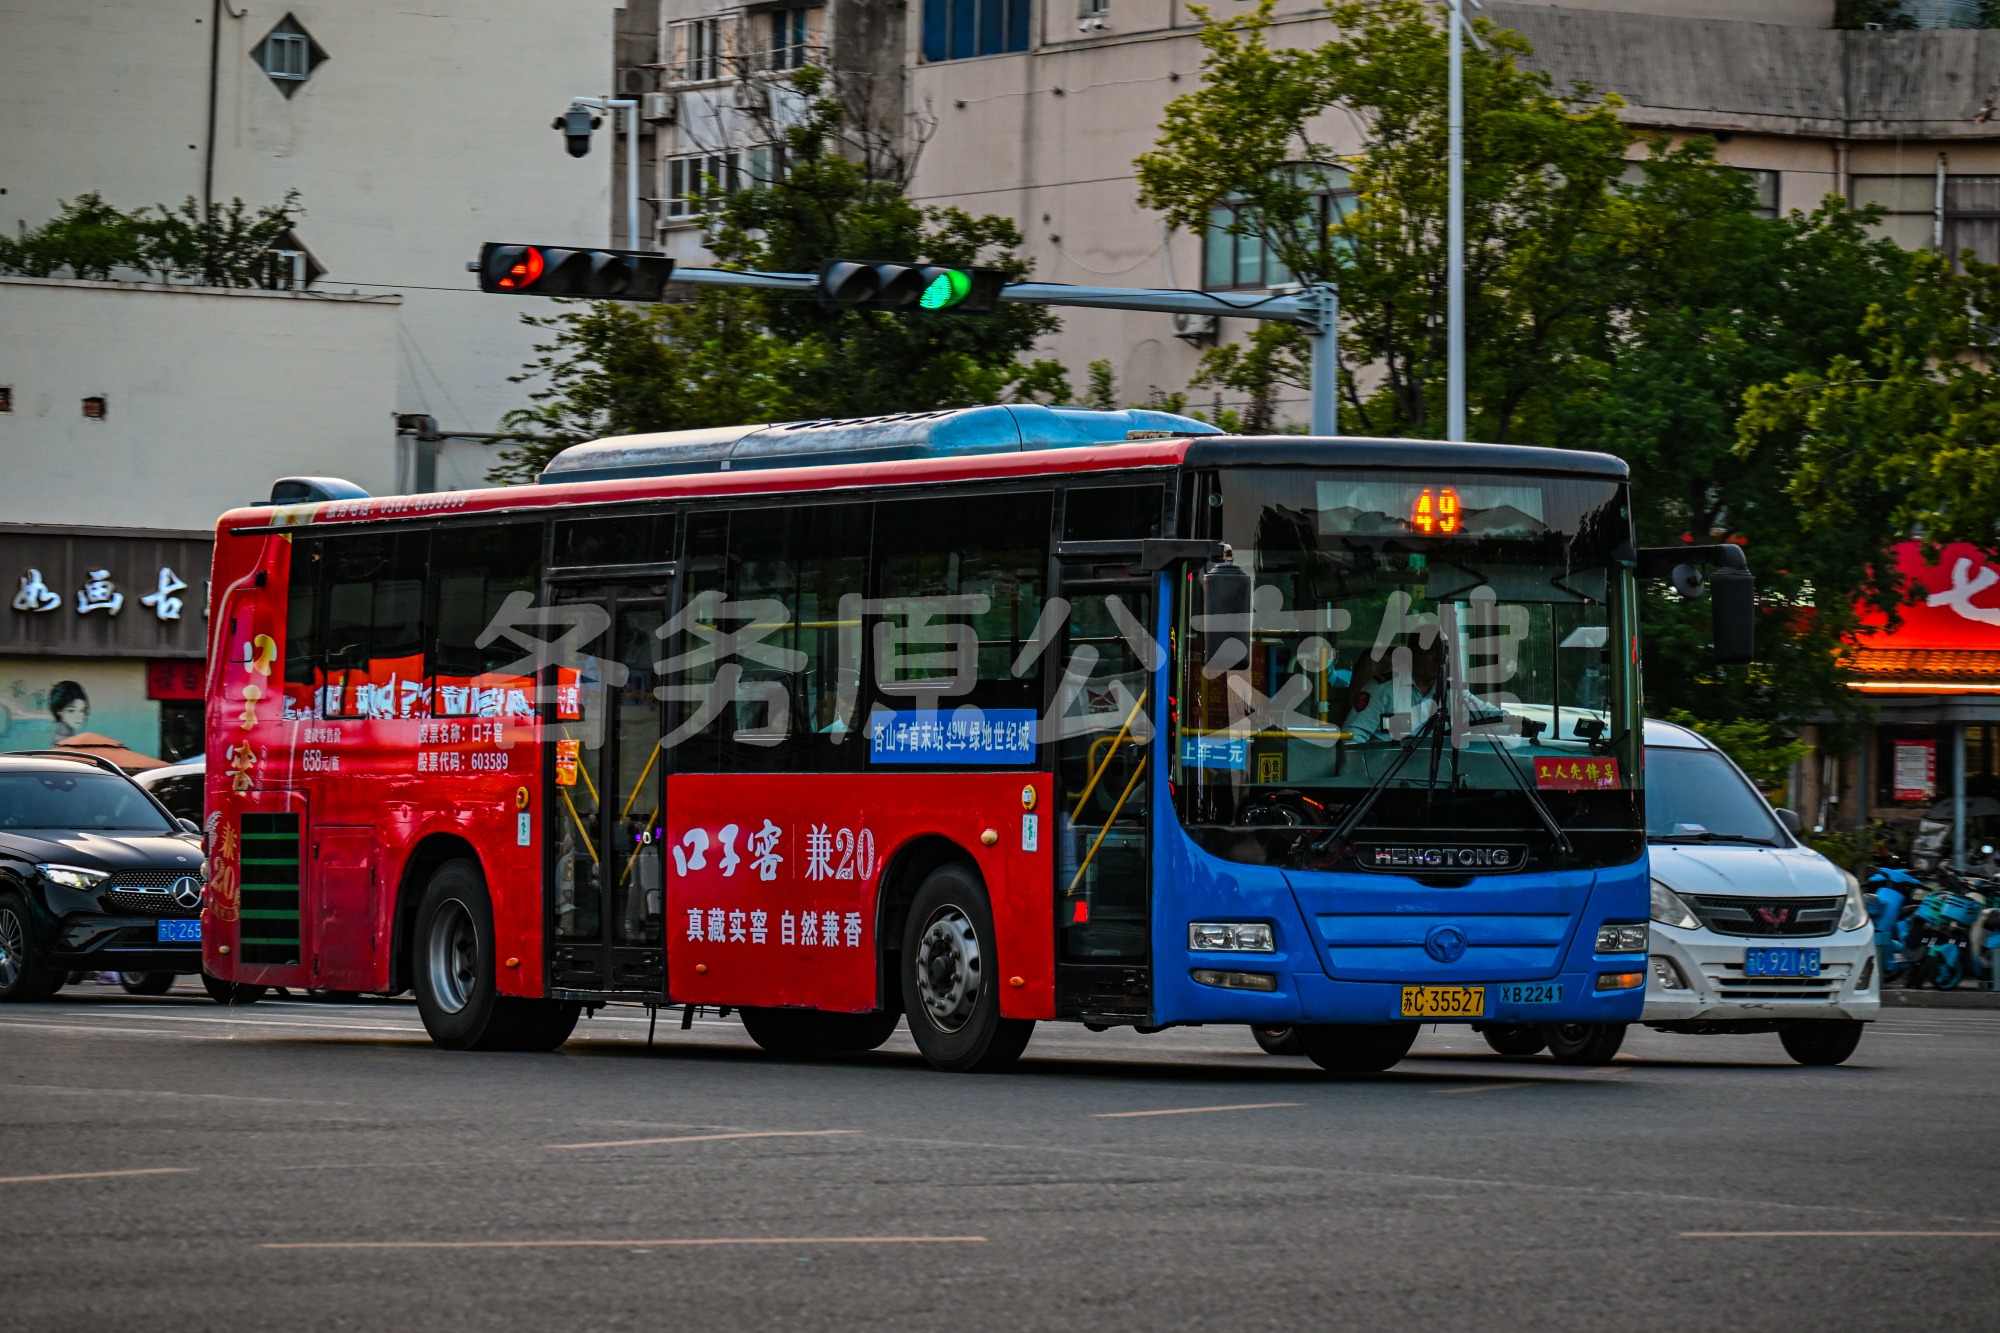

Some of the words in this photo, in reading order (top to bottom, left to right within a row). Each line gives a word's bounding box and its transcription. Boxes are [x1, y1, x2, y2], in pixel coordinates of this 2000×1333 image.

[1416, 488, 1455, 532] 49
[13, 567, 211, 620] 如画古
[873, 720, 944, 753] 杏山子首末站
[946, 719, 968, 740] 49W
[969, 720, 1030, 752] 绿地世纪城
[1181, 741, 1244, 763] 上车二元
[1539, 762, 1614, 783] 工人先锋号
[673, 818, 784, 882] 口子窖
[1374, 847, 1510, 866] HENGTONG
[686, 907, 769, 945] 真藏实窖
[780, 909, 863, 948] 自然兼香
[1501, 986, 1564, 1003] XB2241
